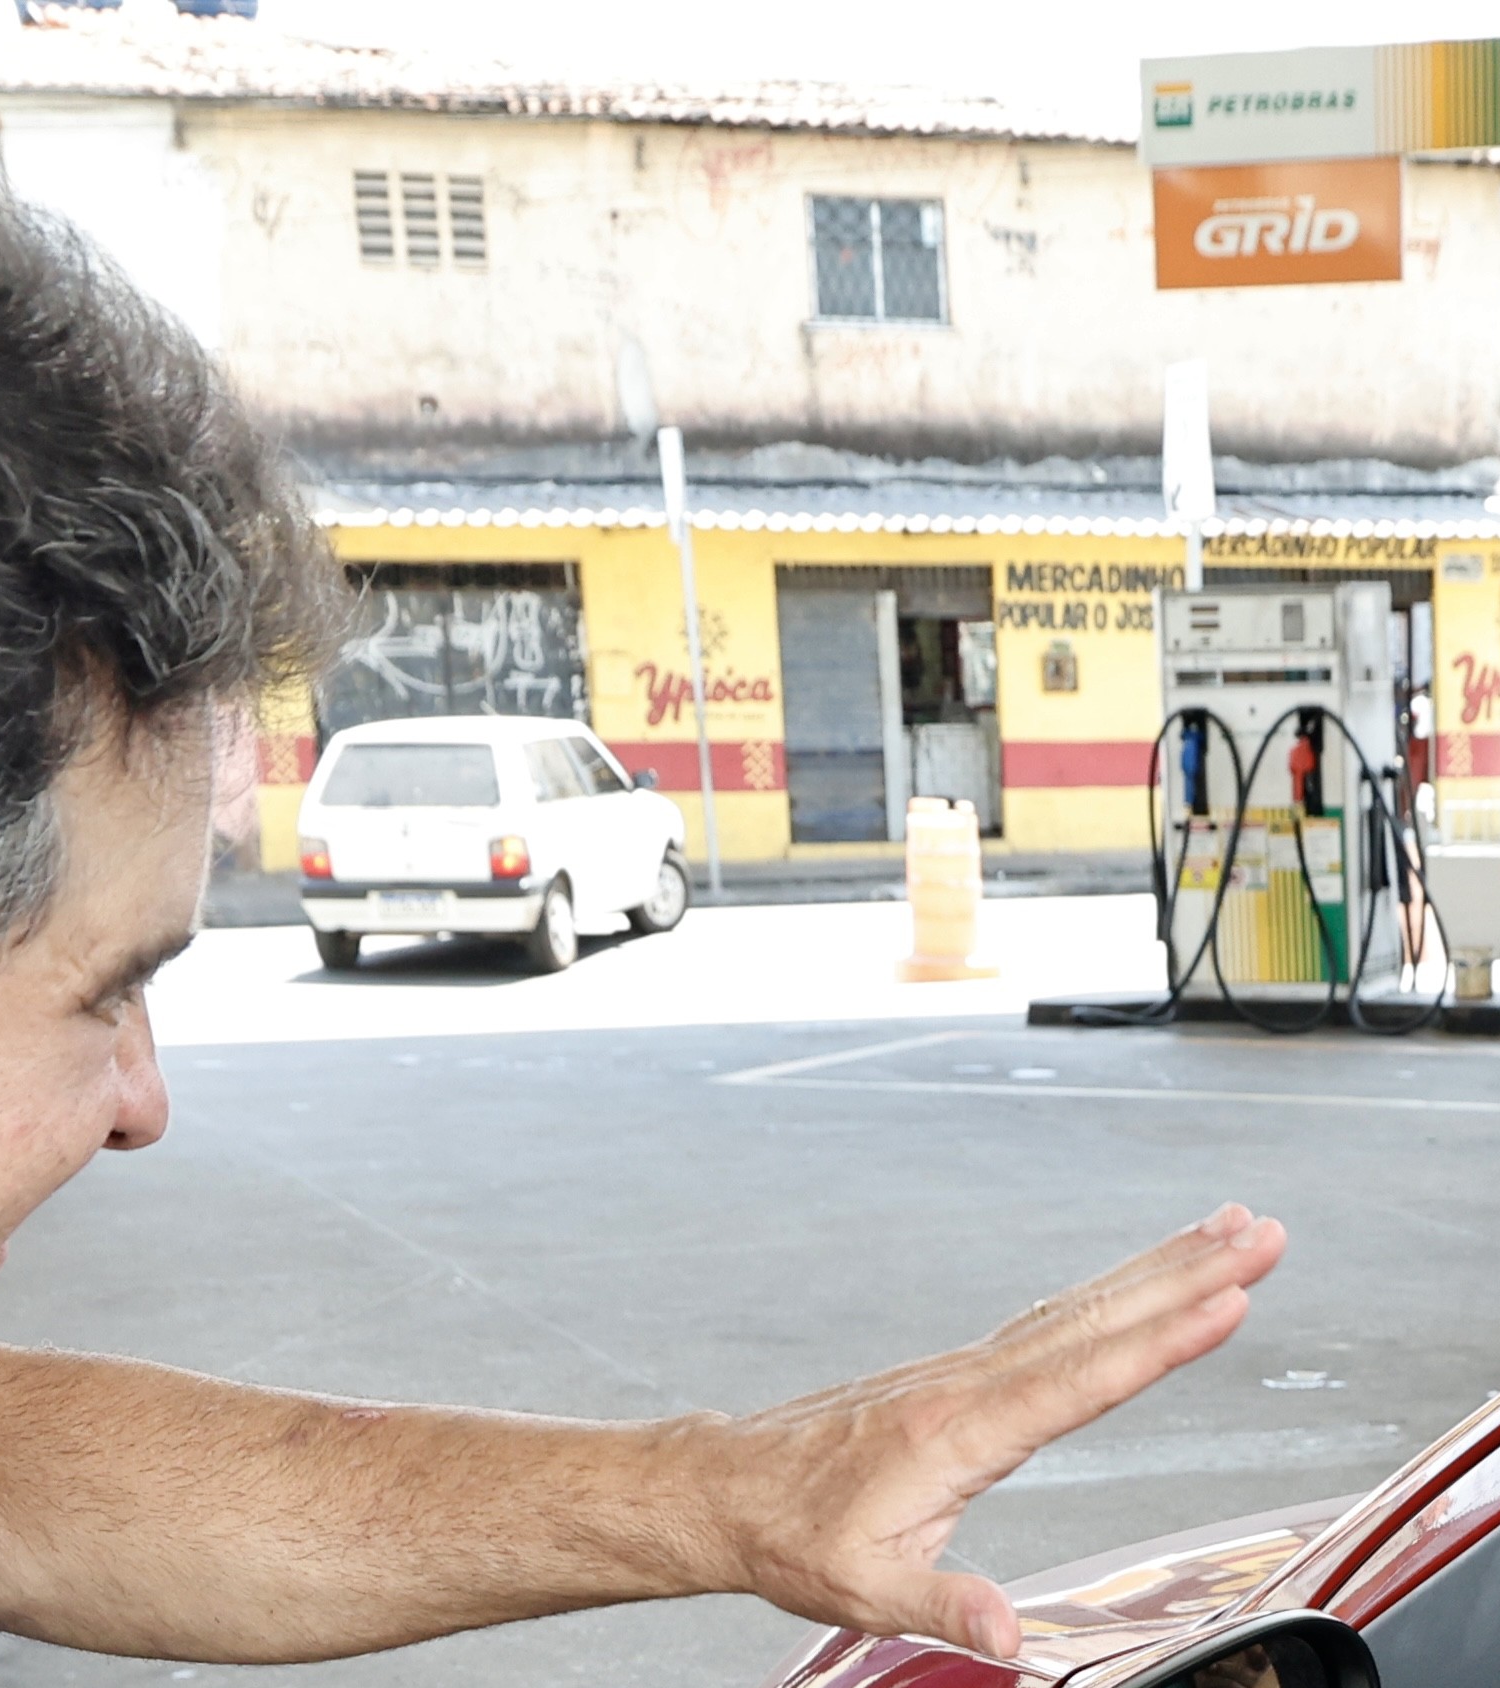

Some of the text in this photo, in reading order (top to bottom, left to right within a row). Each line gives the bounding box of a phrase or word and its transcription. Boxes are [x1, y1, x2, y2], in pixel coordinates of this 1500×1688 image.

[1208, 91, 1357, 113] PETROBRAS
[1194, 195, 1359, 257] GRID
[1006, 561, 1185, 594] MERCADINHO
[999, 603, 1089, 630] POPULAR
